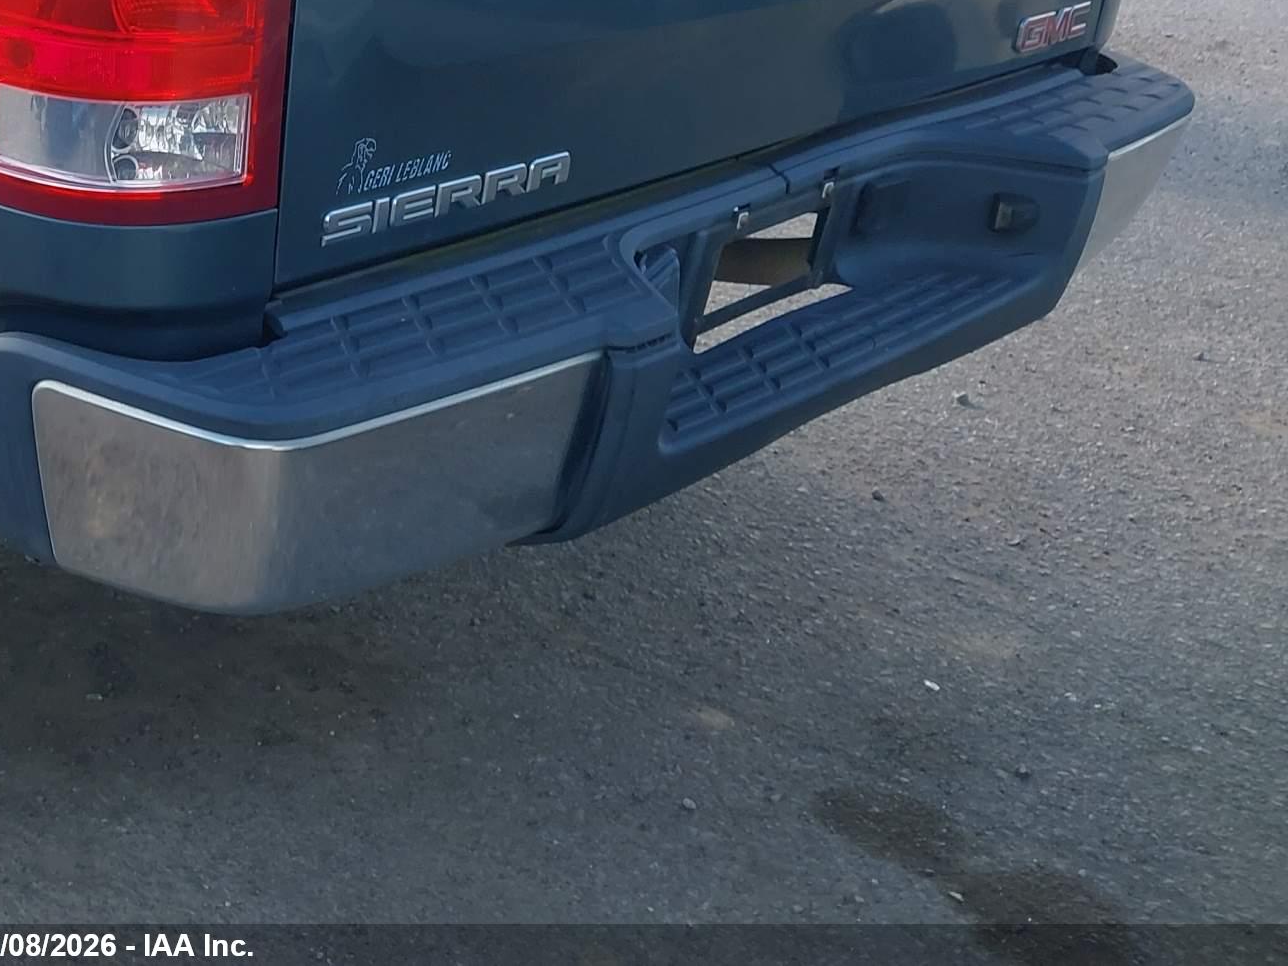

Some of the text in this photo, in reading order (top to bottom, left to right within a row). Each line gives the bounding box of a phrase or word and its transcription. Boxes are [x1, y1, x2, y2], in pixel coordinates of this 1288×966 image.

[1016, 1, 1091, 52] GMC
[321, 151, 571, 247] SIERRA
[363, 164, 396, 192] GERI
